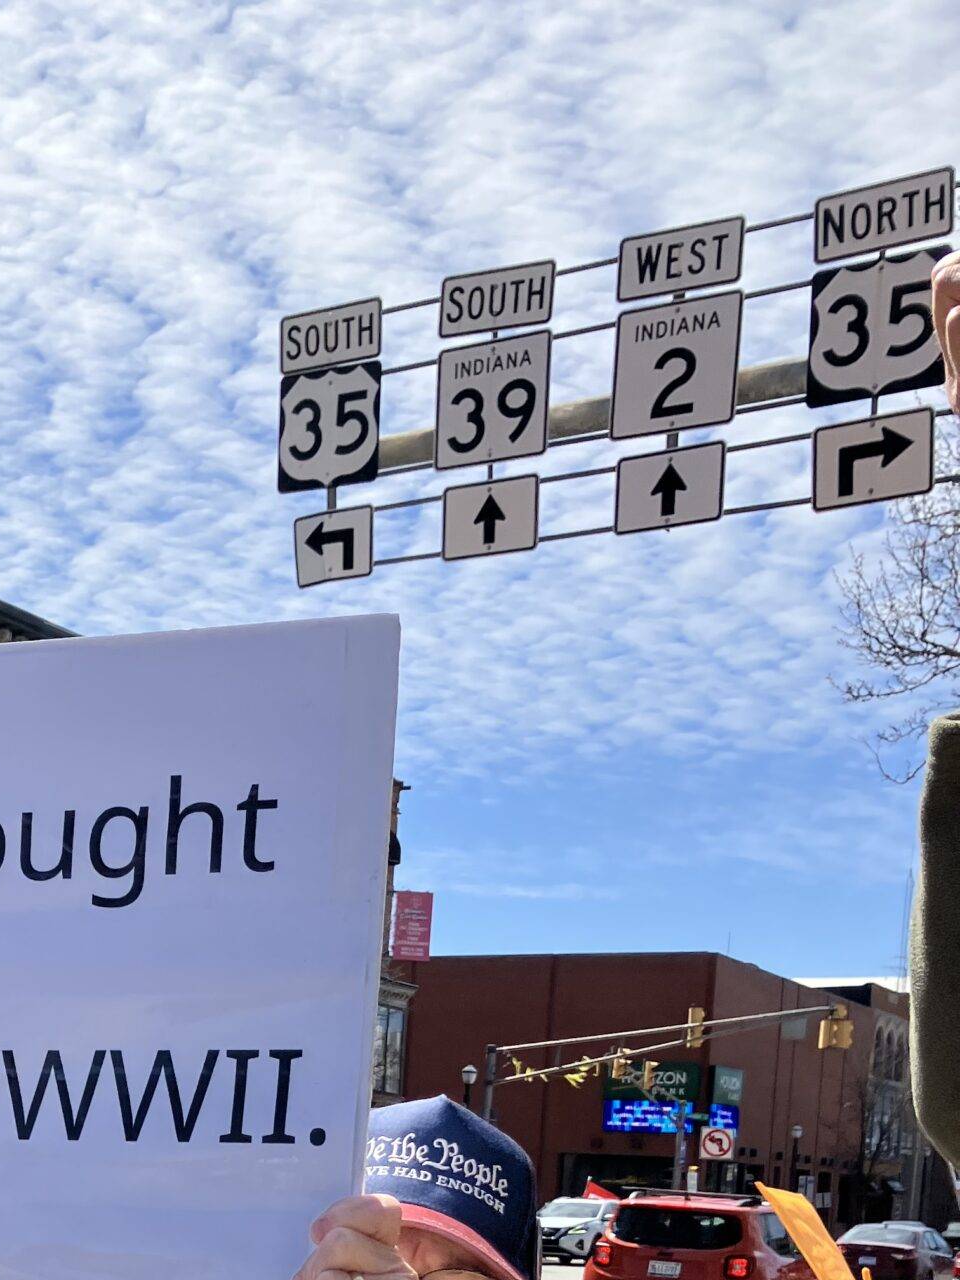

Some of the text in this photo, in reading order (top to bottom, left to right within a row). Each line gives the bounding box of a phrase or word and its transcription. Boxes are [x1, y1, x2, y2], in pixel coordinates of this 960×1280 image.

[822, 183, 946, 249] NORTH
[636, 232, 730, 285] WEST
[445, 275, 546, 324] SOUTH
[634, 309, 722, 344] INDIANA
[822, 279, 934, 368] 35
[285, 311, 374, 361] SOUTH
[453, 349, 532, 380] INDIANA
[446, 377, 537, 454] 39
[650, 346, 697, 420] 2
[288, 388, 369, 461] 35
[0, 1048, 329, 1148] WWII.
[388, 1132, 429, 1165] the
[421, 1137, 508, 1198] People
[392, 1166, 432, 1182] HAD
[435, 1174, 506, 1215] ENOUGH
